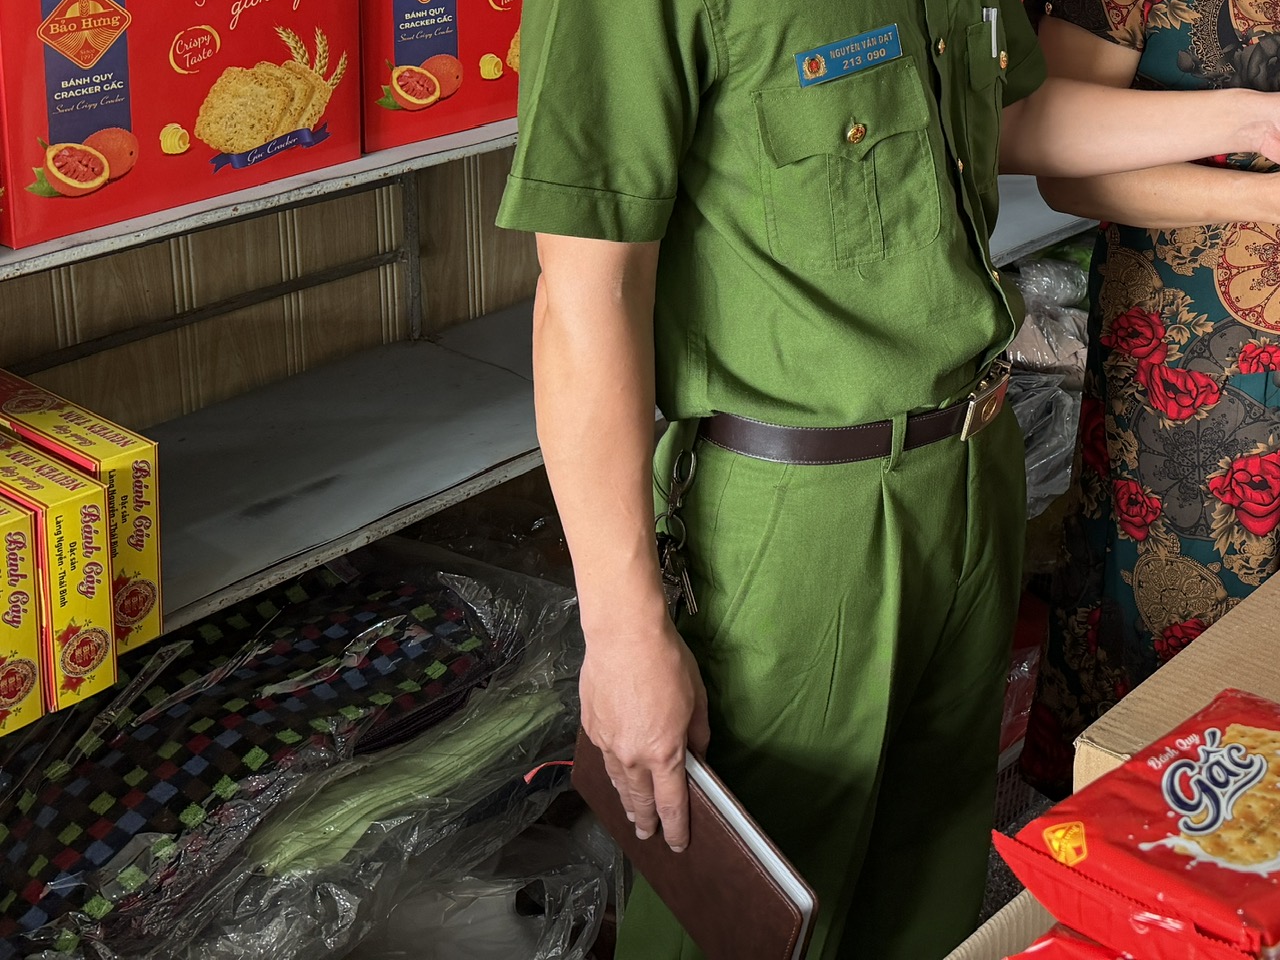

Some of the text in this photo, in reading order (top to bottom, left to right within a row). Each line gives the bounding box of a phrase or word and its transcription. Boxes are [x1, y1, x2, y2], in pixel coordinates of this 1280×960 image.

[404, 6, 445, 20] BÁNH QUY
[49, 14, 120, 35] Bảo Hưng
[399, 18, 435, 30] CRACKER
[175, 32, 211, 56] Crispy
[183, 48, 214, 68] Taste
[843, 48, 886, 70] 213 090
[61, 72, 113, 89] BÁNH QUY
[54, 86, 102, 100] CRACKER
[52, 95, 126, 115] Sweet Crispy Cracker
[266, 136, 298, 155] Cracker
[127, 460, 152, 552] Bánh Cáy
[54, 515, 63, 535] Làng
[69, 541, 77, 557] Đặc
[77, 503, 103, 599] Bánh Cáy
[2, 531, 30, 629] Bánh Cáy
[58, 571, 67, 590] Thái
[60, 590, 68, 608] Bình
[1147, 732, 1201, 770] Bánh Quy
